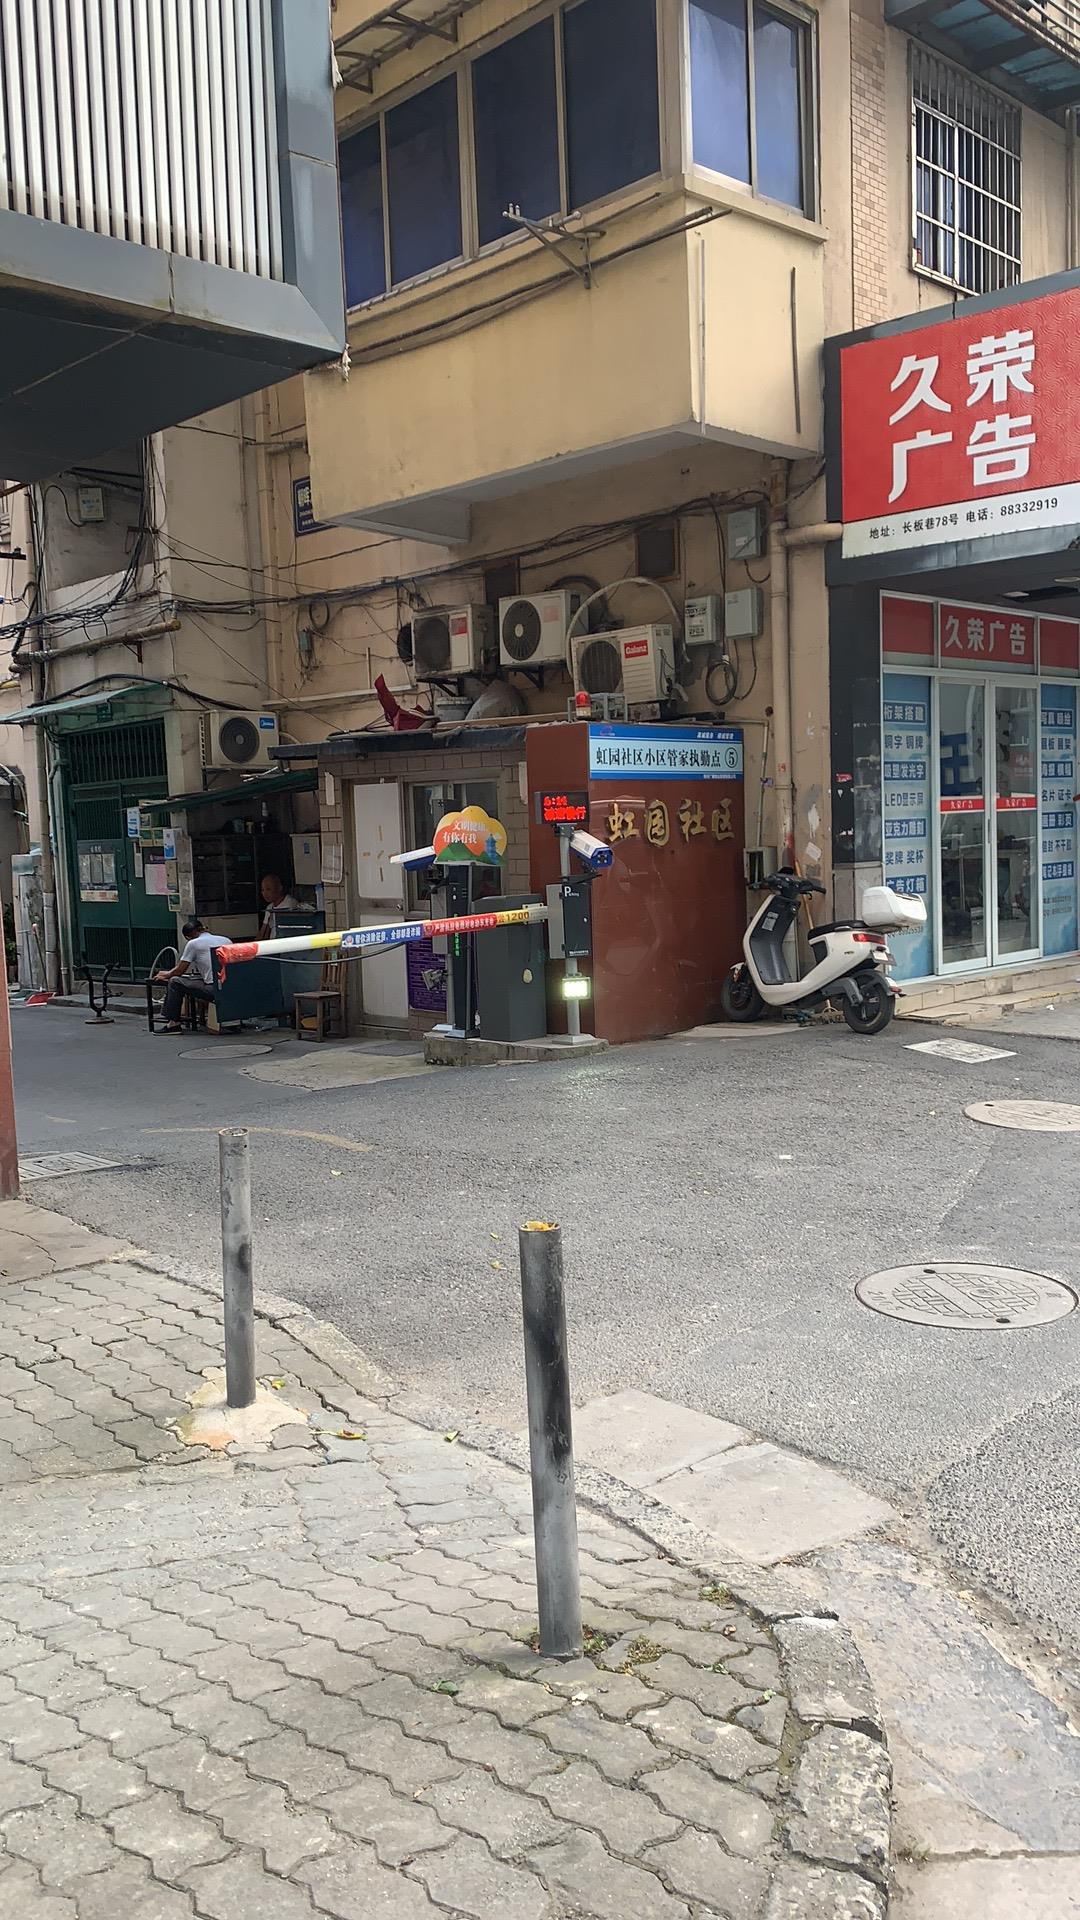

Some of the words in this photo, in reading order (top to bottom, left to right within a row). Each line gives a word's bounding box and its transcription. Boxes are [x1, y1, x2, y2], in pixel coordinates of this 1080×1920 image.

[889, 329, 1036, 426] 久荣
[887, 413, 1037, 504] 广告
[902, 513, 960, 533] 长板巷78号
[1000, 497, 1059, 517] 88332919
[944, 615, 1026, 656] 久荣广告
[885, 792, 924, 806] LED显示屏
[907, 849, 924, 864] 奖杯
[886, 877, 926, 894] 广告灯箱
